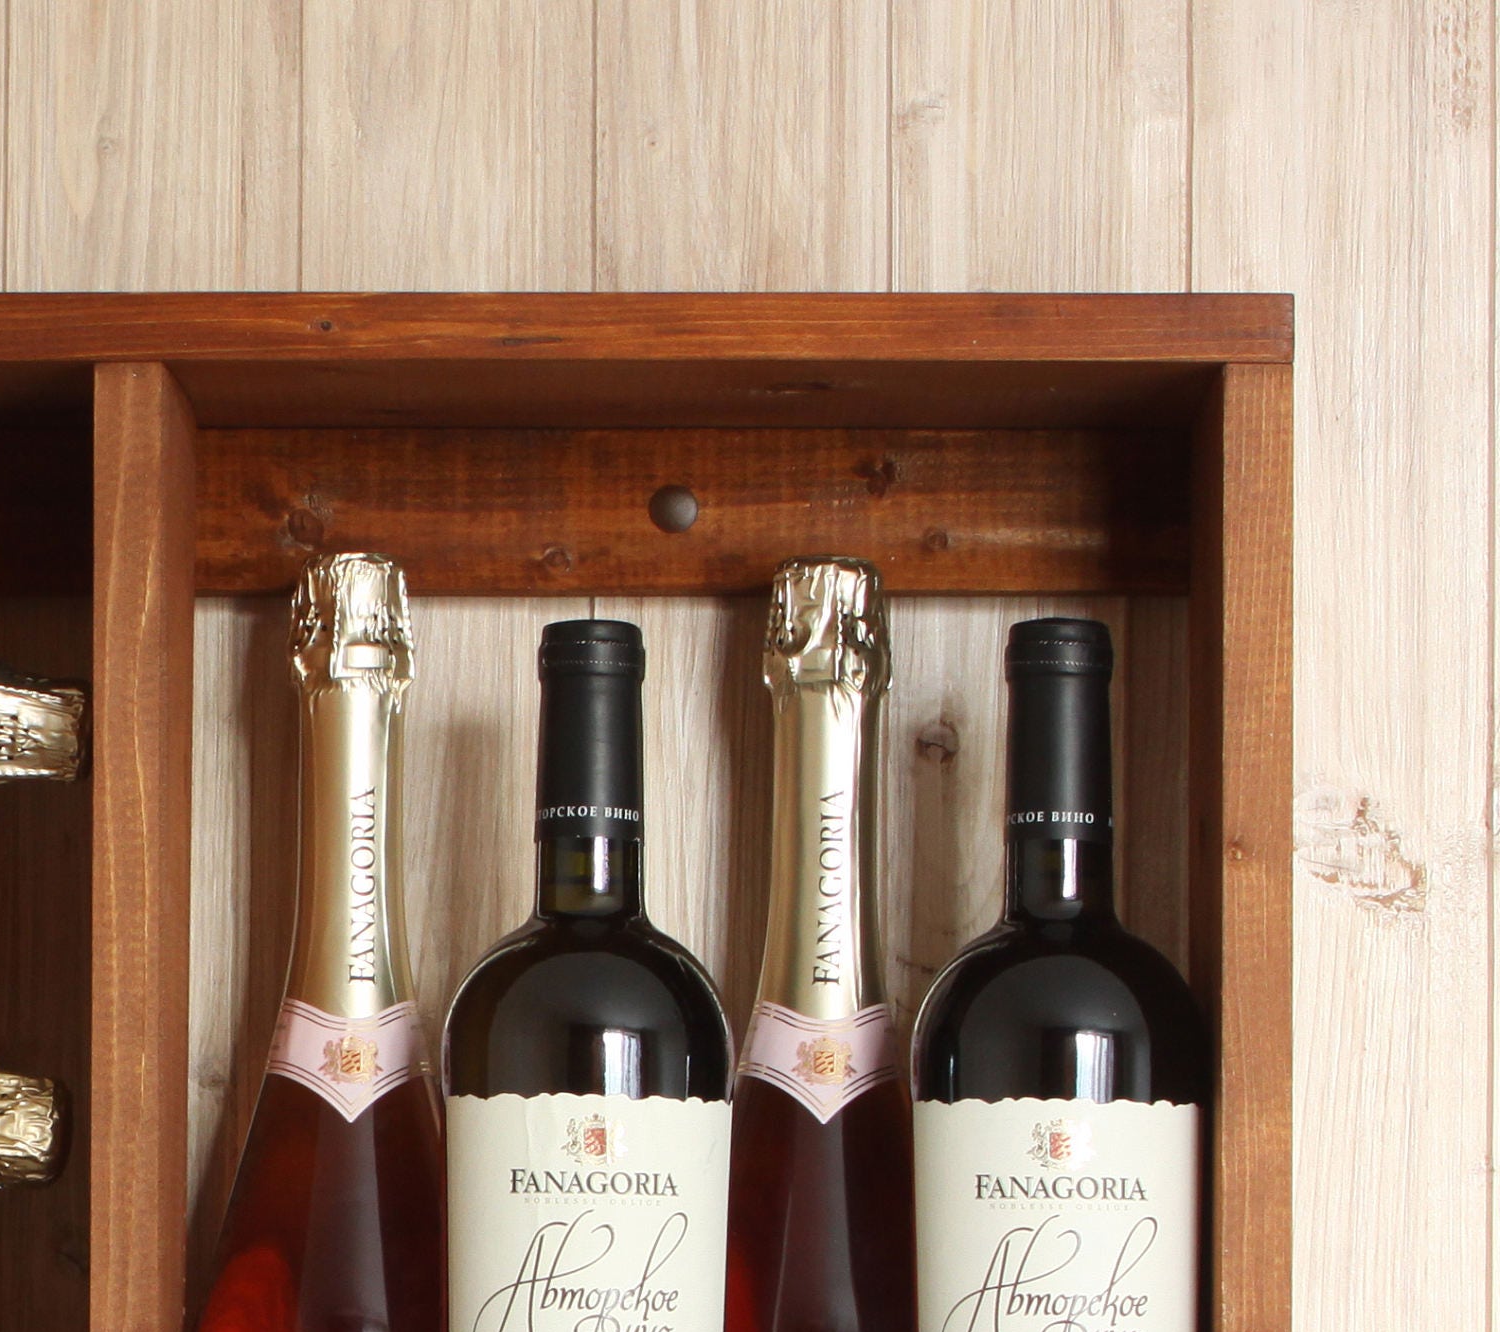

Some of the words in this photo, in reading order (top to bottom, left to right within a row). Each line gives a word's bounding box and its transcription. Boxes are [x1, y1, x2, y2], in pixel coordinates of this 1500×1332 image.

[604, 807, 639, 821] ВИНО
[1051, 811, 1095, 824] ВИНО
[348, 786, 376, 985] FANAGORIA
[812, 790, 844, 986] FANAGORIA
[510, 1168, 678, 1196] FANAGORIA
[975, 1174, 1147, 1200] FANAGORIA
